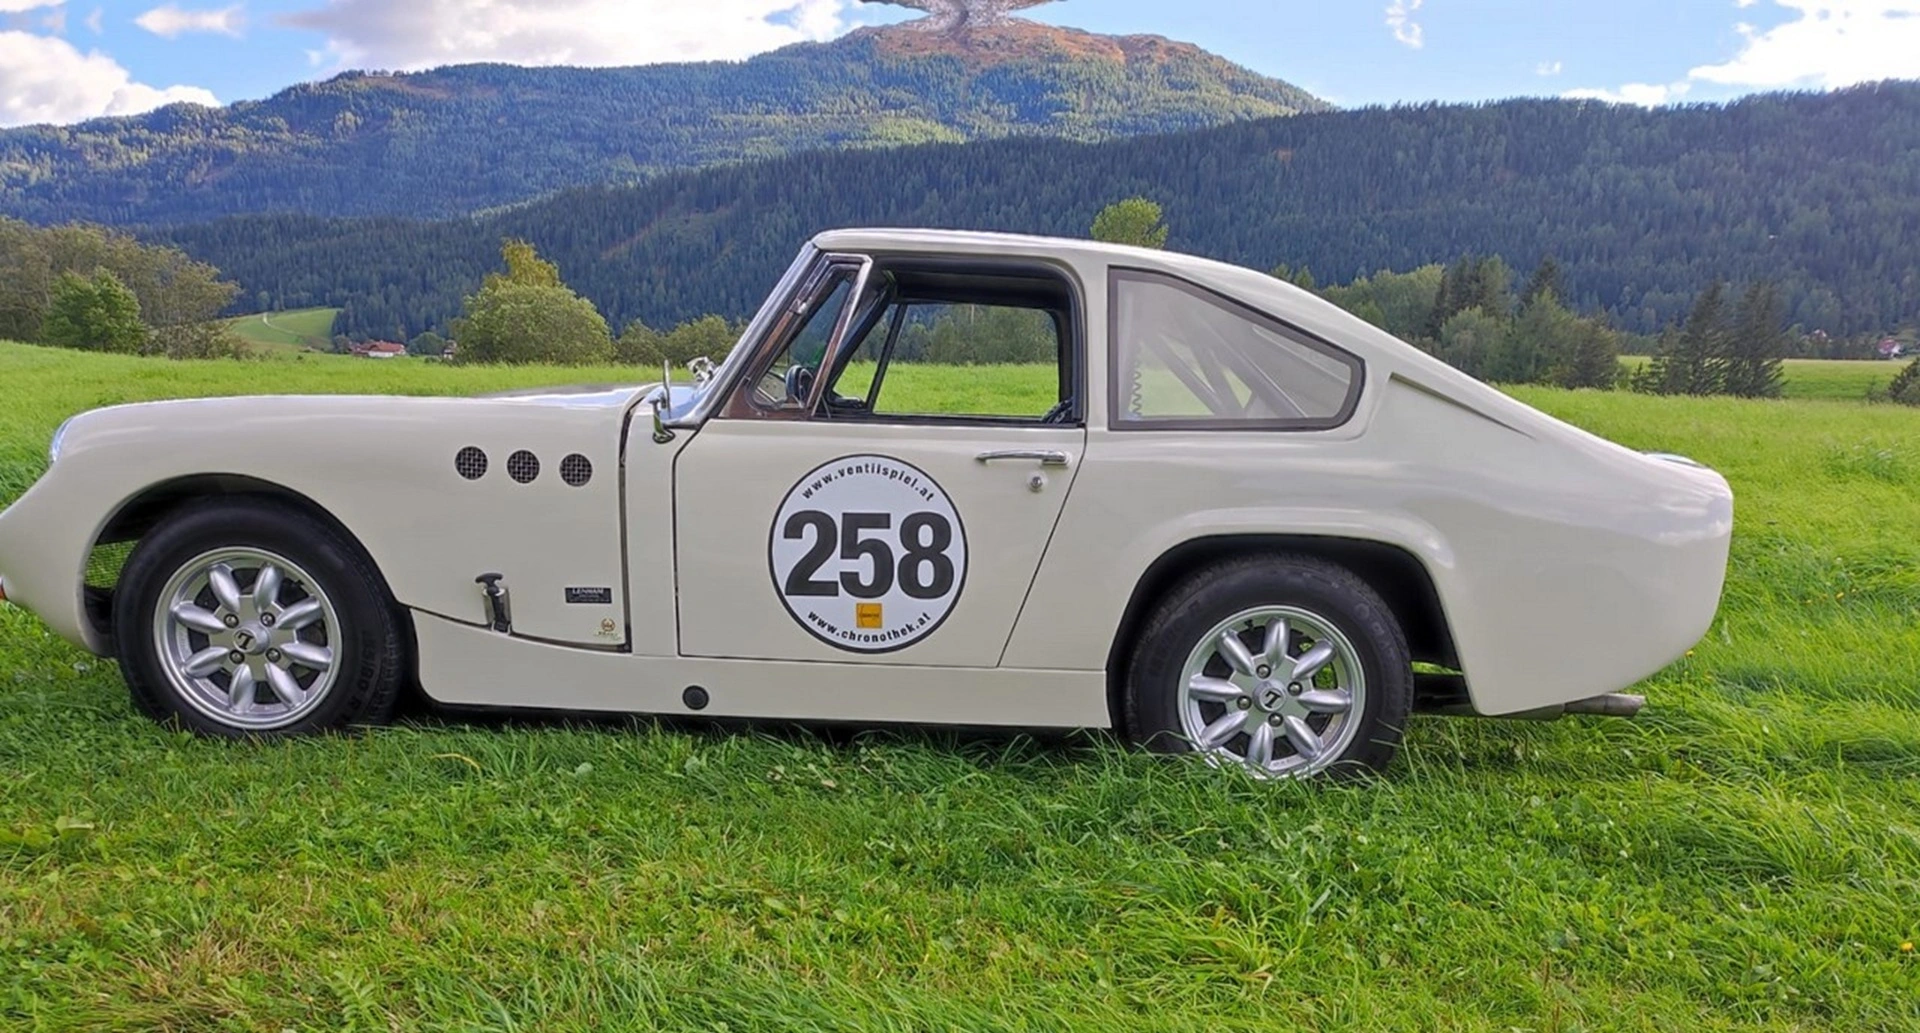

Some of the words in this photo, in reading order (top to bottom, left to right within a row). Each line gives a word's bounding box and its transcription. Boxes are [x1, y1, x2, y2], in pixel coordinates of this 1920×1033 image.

[802, 463, 934, 501] www.ventilspiel.at
[783, 510, 955, 600] 258
[808, 612, 931, 643] www.chronothek.at
